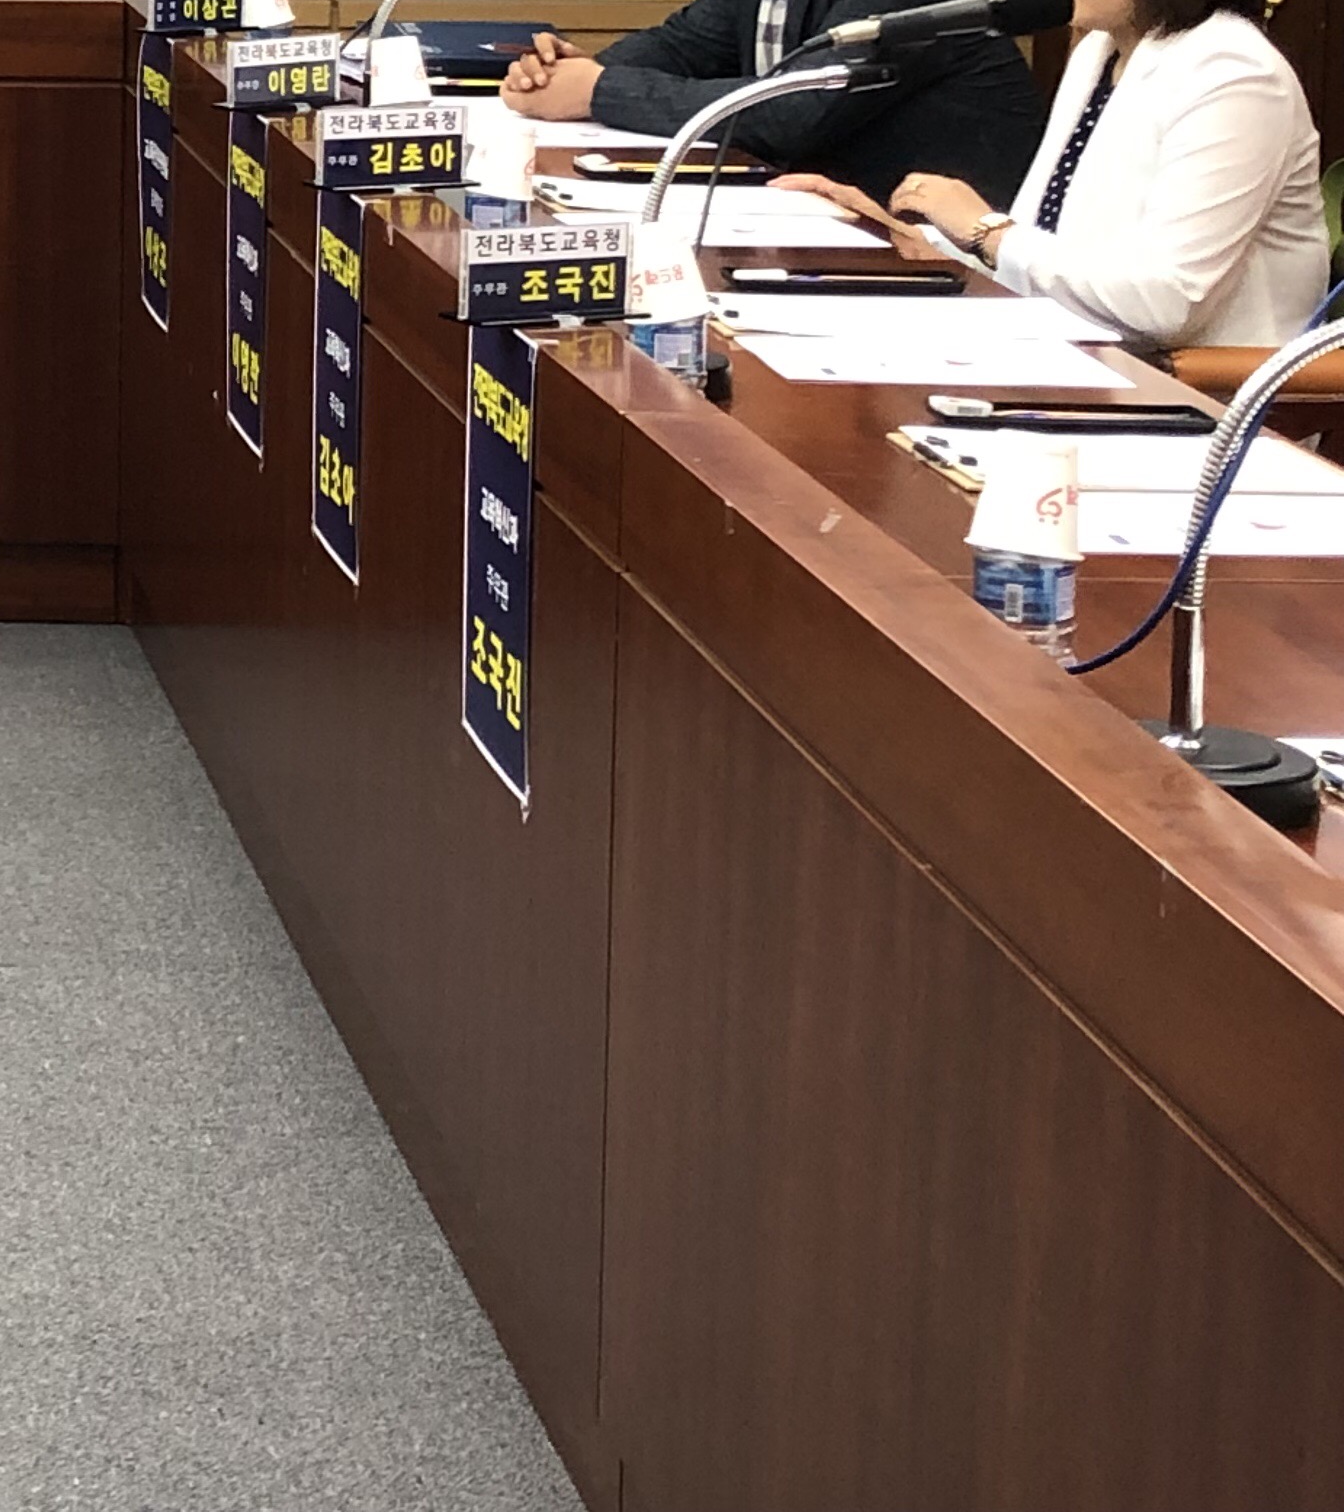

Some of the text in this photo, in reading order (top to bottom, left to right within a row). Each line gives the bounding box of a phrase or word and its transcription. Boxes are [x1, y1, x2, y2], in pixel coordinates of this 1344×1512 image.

[268, 64, 331, 96] 이영란
[329, 111, 457, 135] 전라북도교육청
[369, 139, 456, 175] 김초아
[475, 229, 621, 257] 전라북도교육청
[520, 262, 617, 304] 조국진
[471, 615, 522, 731] 조국진
